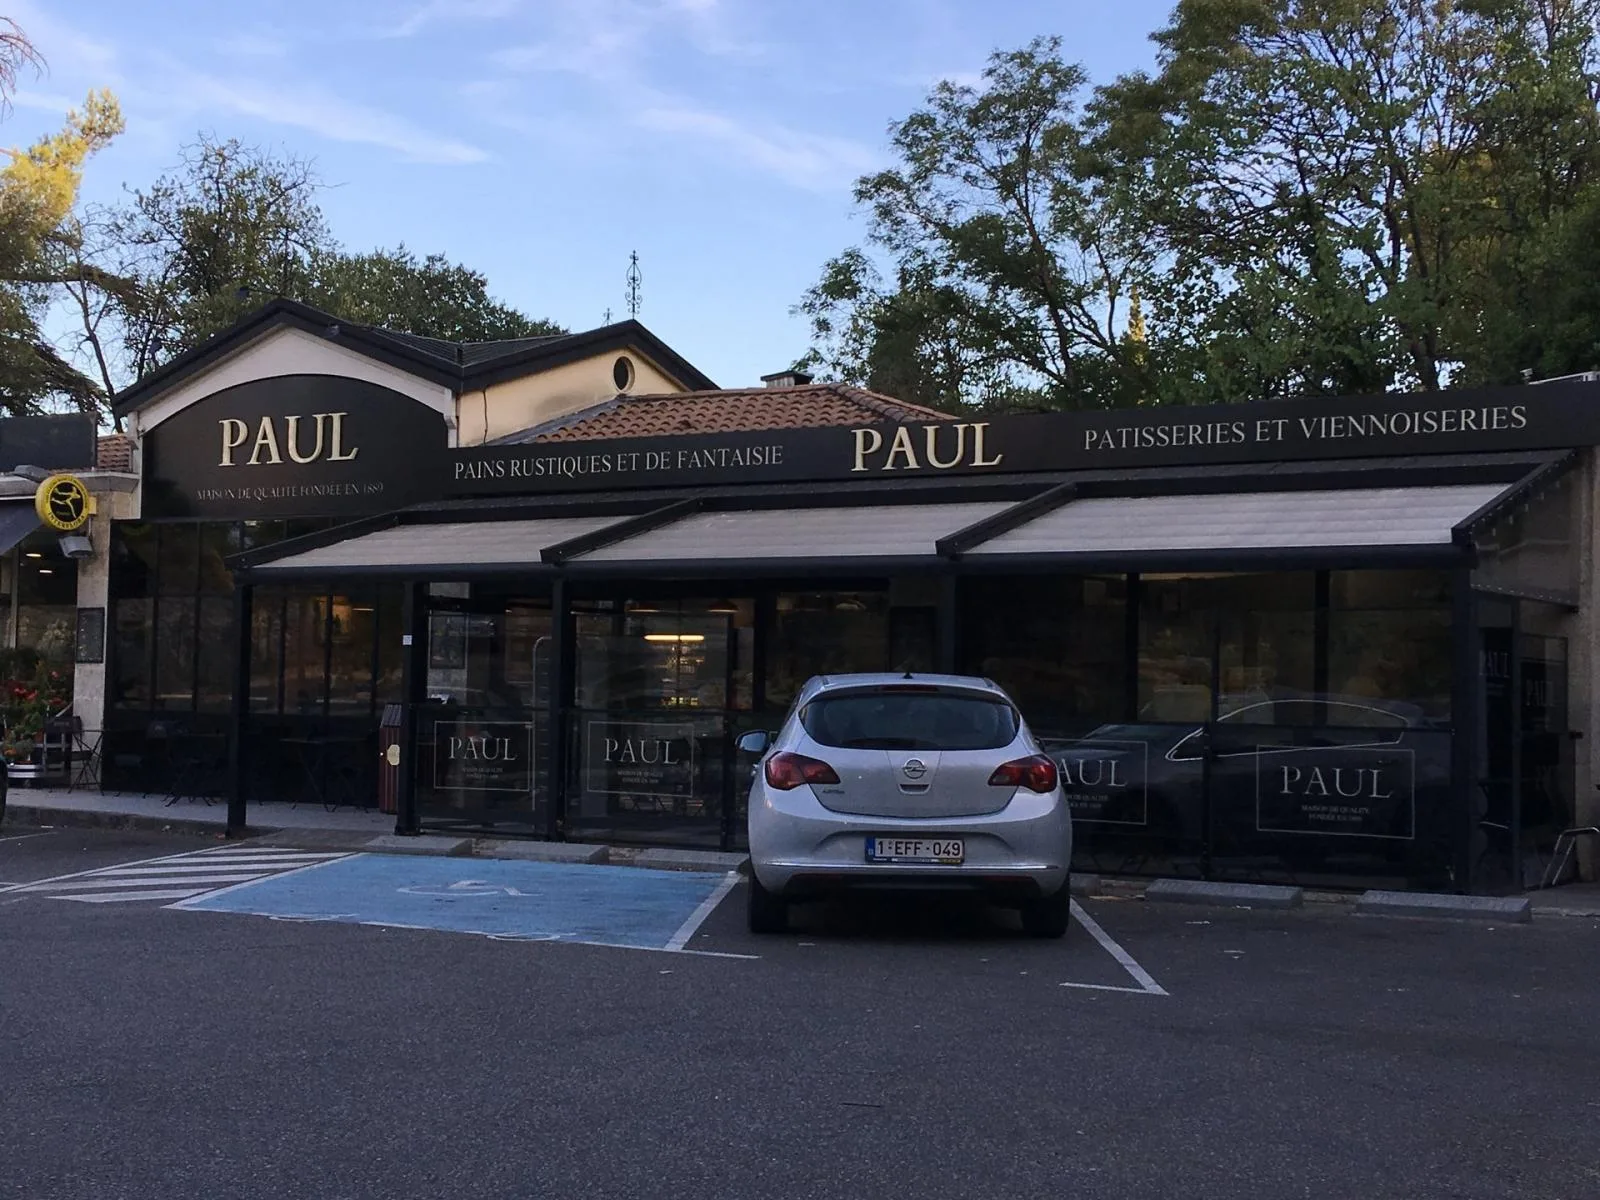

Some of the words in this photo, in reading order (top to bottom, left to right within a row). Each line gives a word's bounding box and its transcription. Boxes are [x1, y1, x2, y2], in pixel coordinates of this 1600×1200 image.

[217, 412, 361, 467] PAUL
[1085, 422, 1245, 450] PATISSERIES
[1255, 419, 1289, 442] ET
[1299, 406, 1528, 440] VIENNOISERIES
[454, 461, 506, 479] PAINS
[510, 454, 612, 478] RUSTIQUES
[616, 452, 641, 472] ET
[645, 450, 672, 471] DE
[676, 445, 784, 468] FANTAISIE
[851, 421, 1004, 472] PAUL
[448, 736, 518, 762] PAUL
[603, 737, 680, 765] PAUL
[1058, 758, 1129, 787] AUL
[1279, 765, 1394, 799] PAUL
